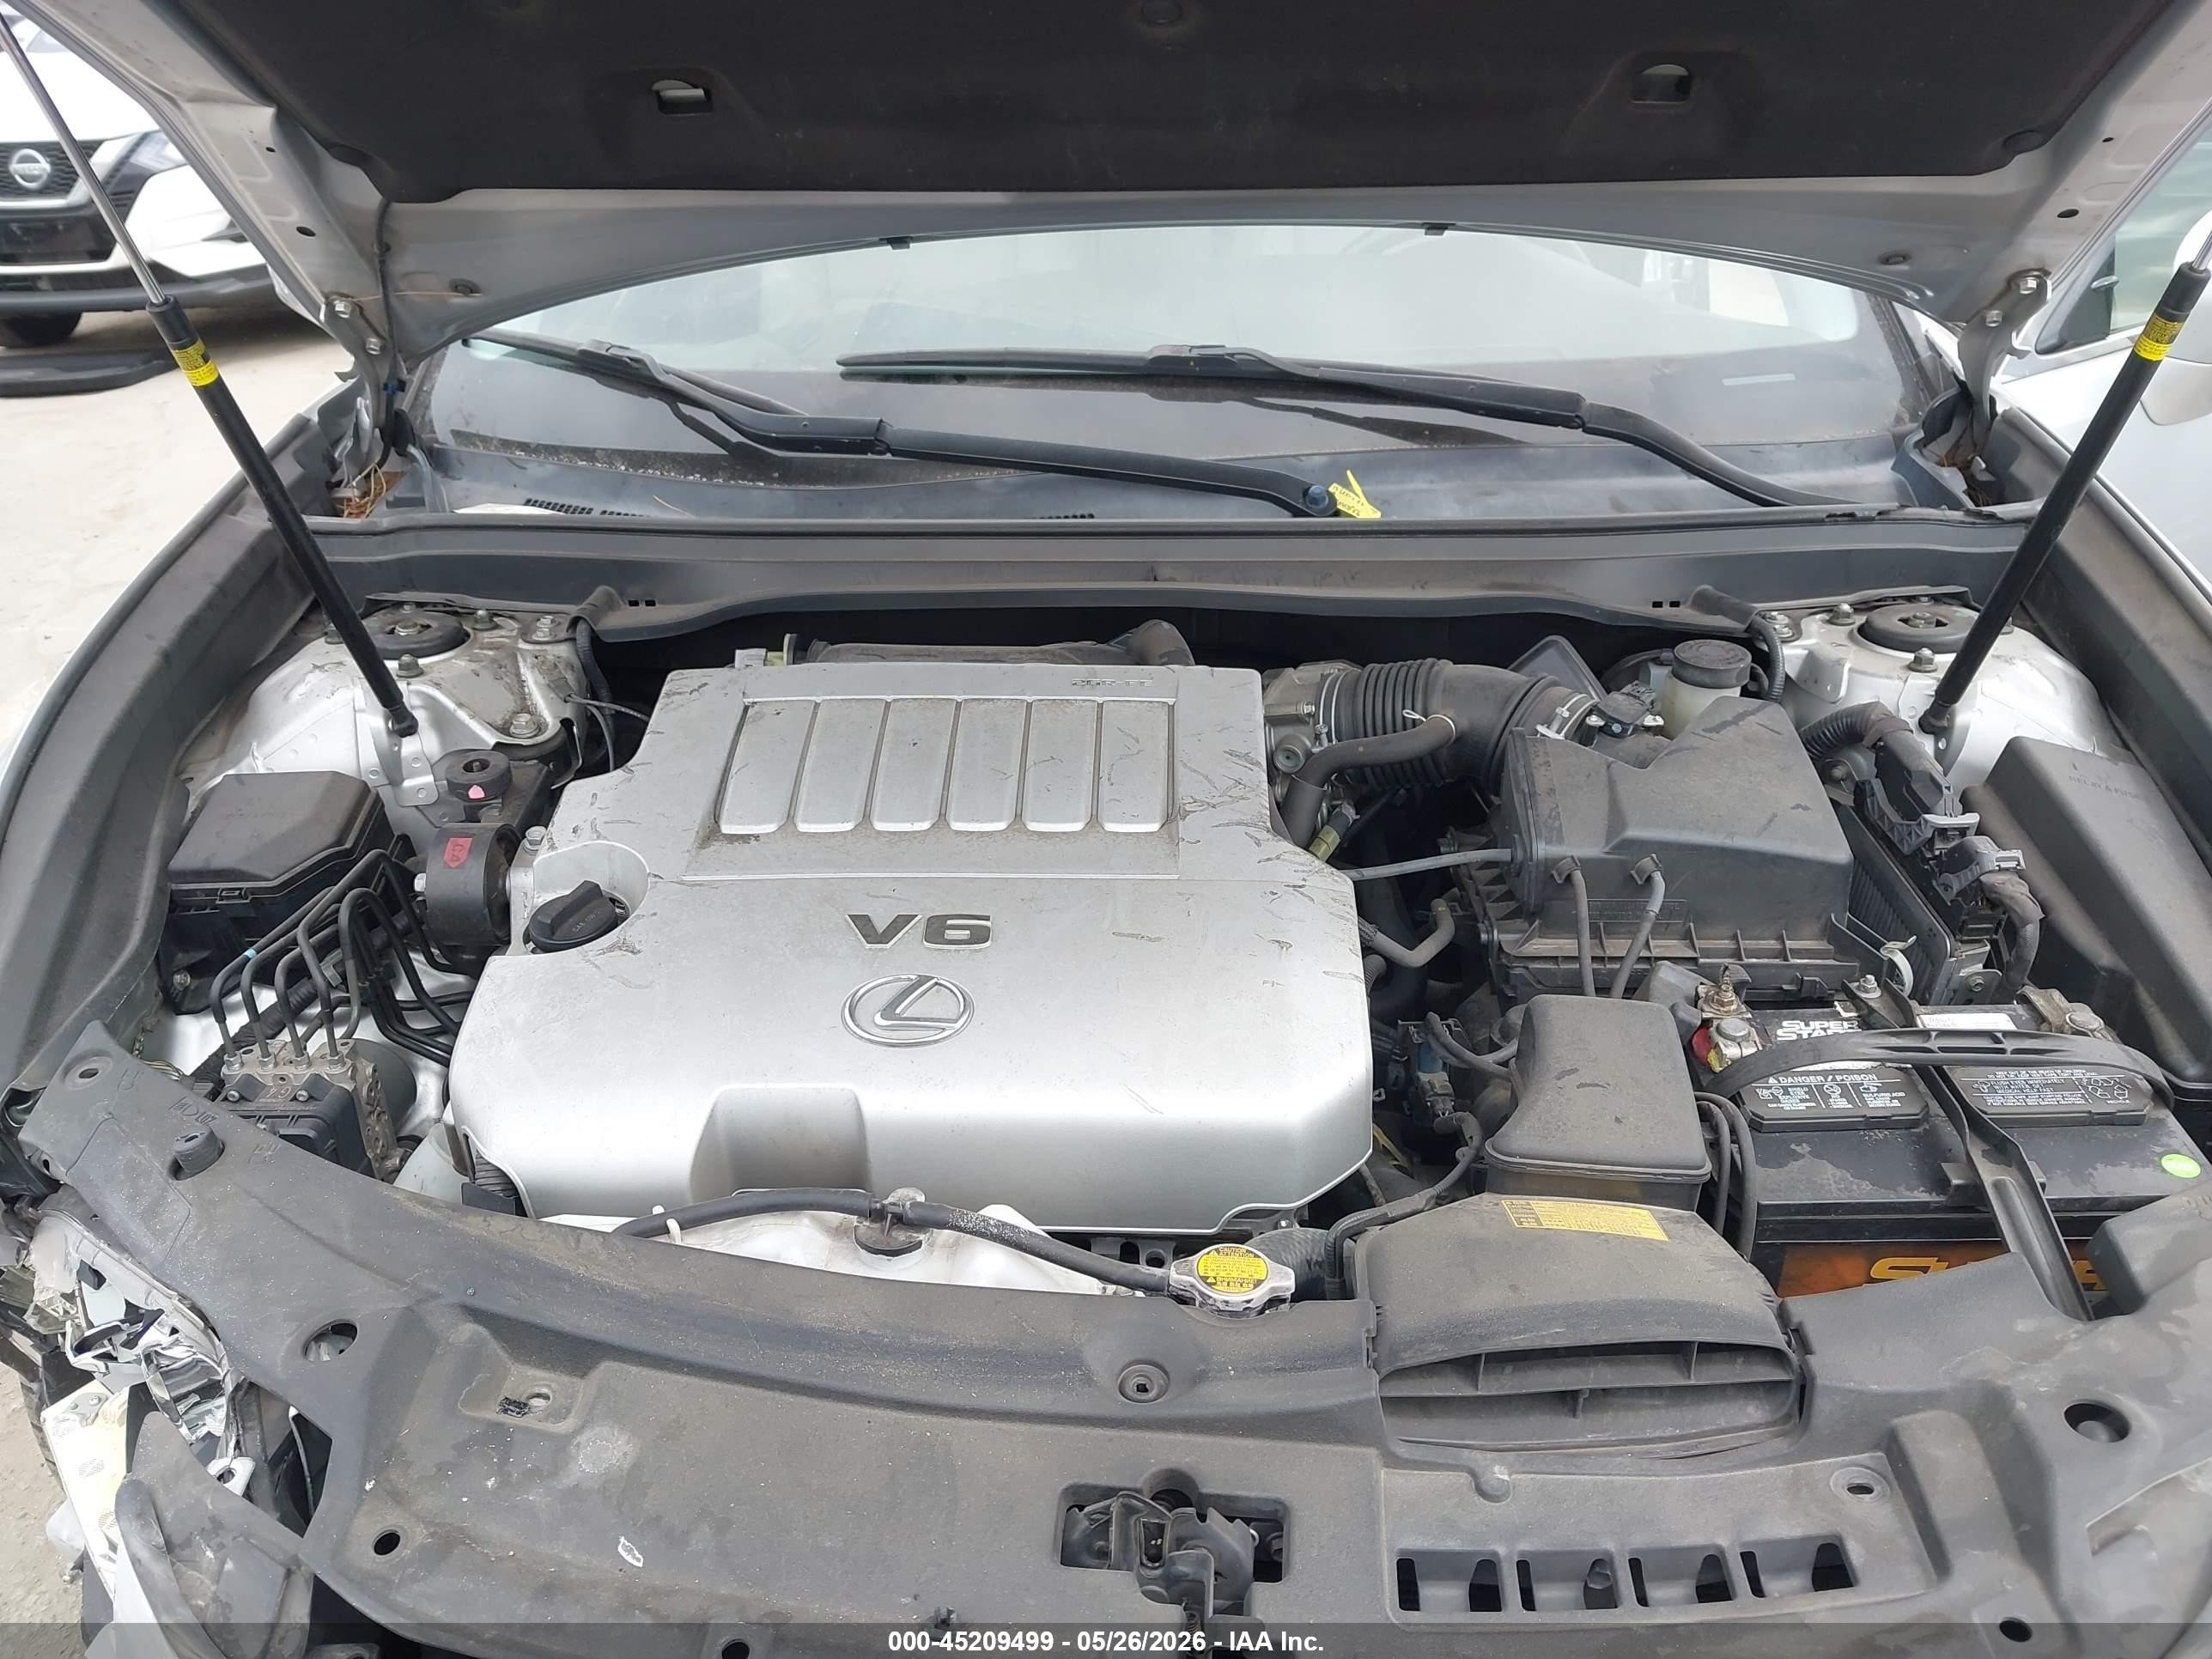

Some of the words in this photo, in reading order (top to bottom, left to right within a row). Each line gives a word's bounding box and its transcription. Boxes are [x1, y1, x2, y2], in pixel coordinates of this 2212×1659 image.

[845, 914, 993, 950] V6
[1781, 1020, 1859, 1030] SUPER
[1778, 1075, 1826, 1084] DANGER
[1835, 1073, 1878, 1082] POISON
